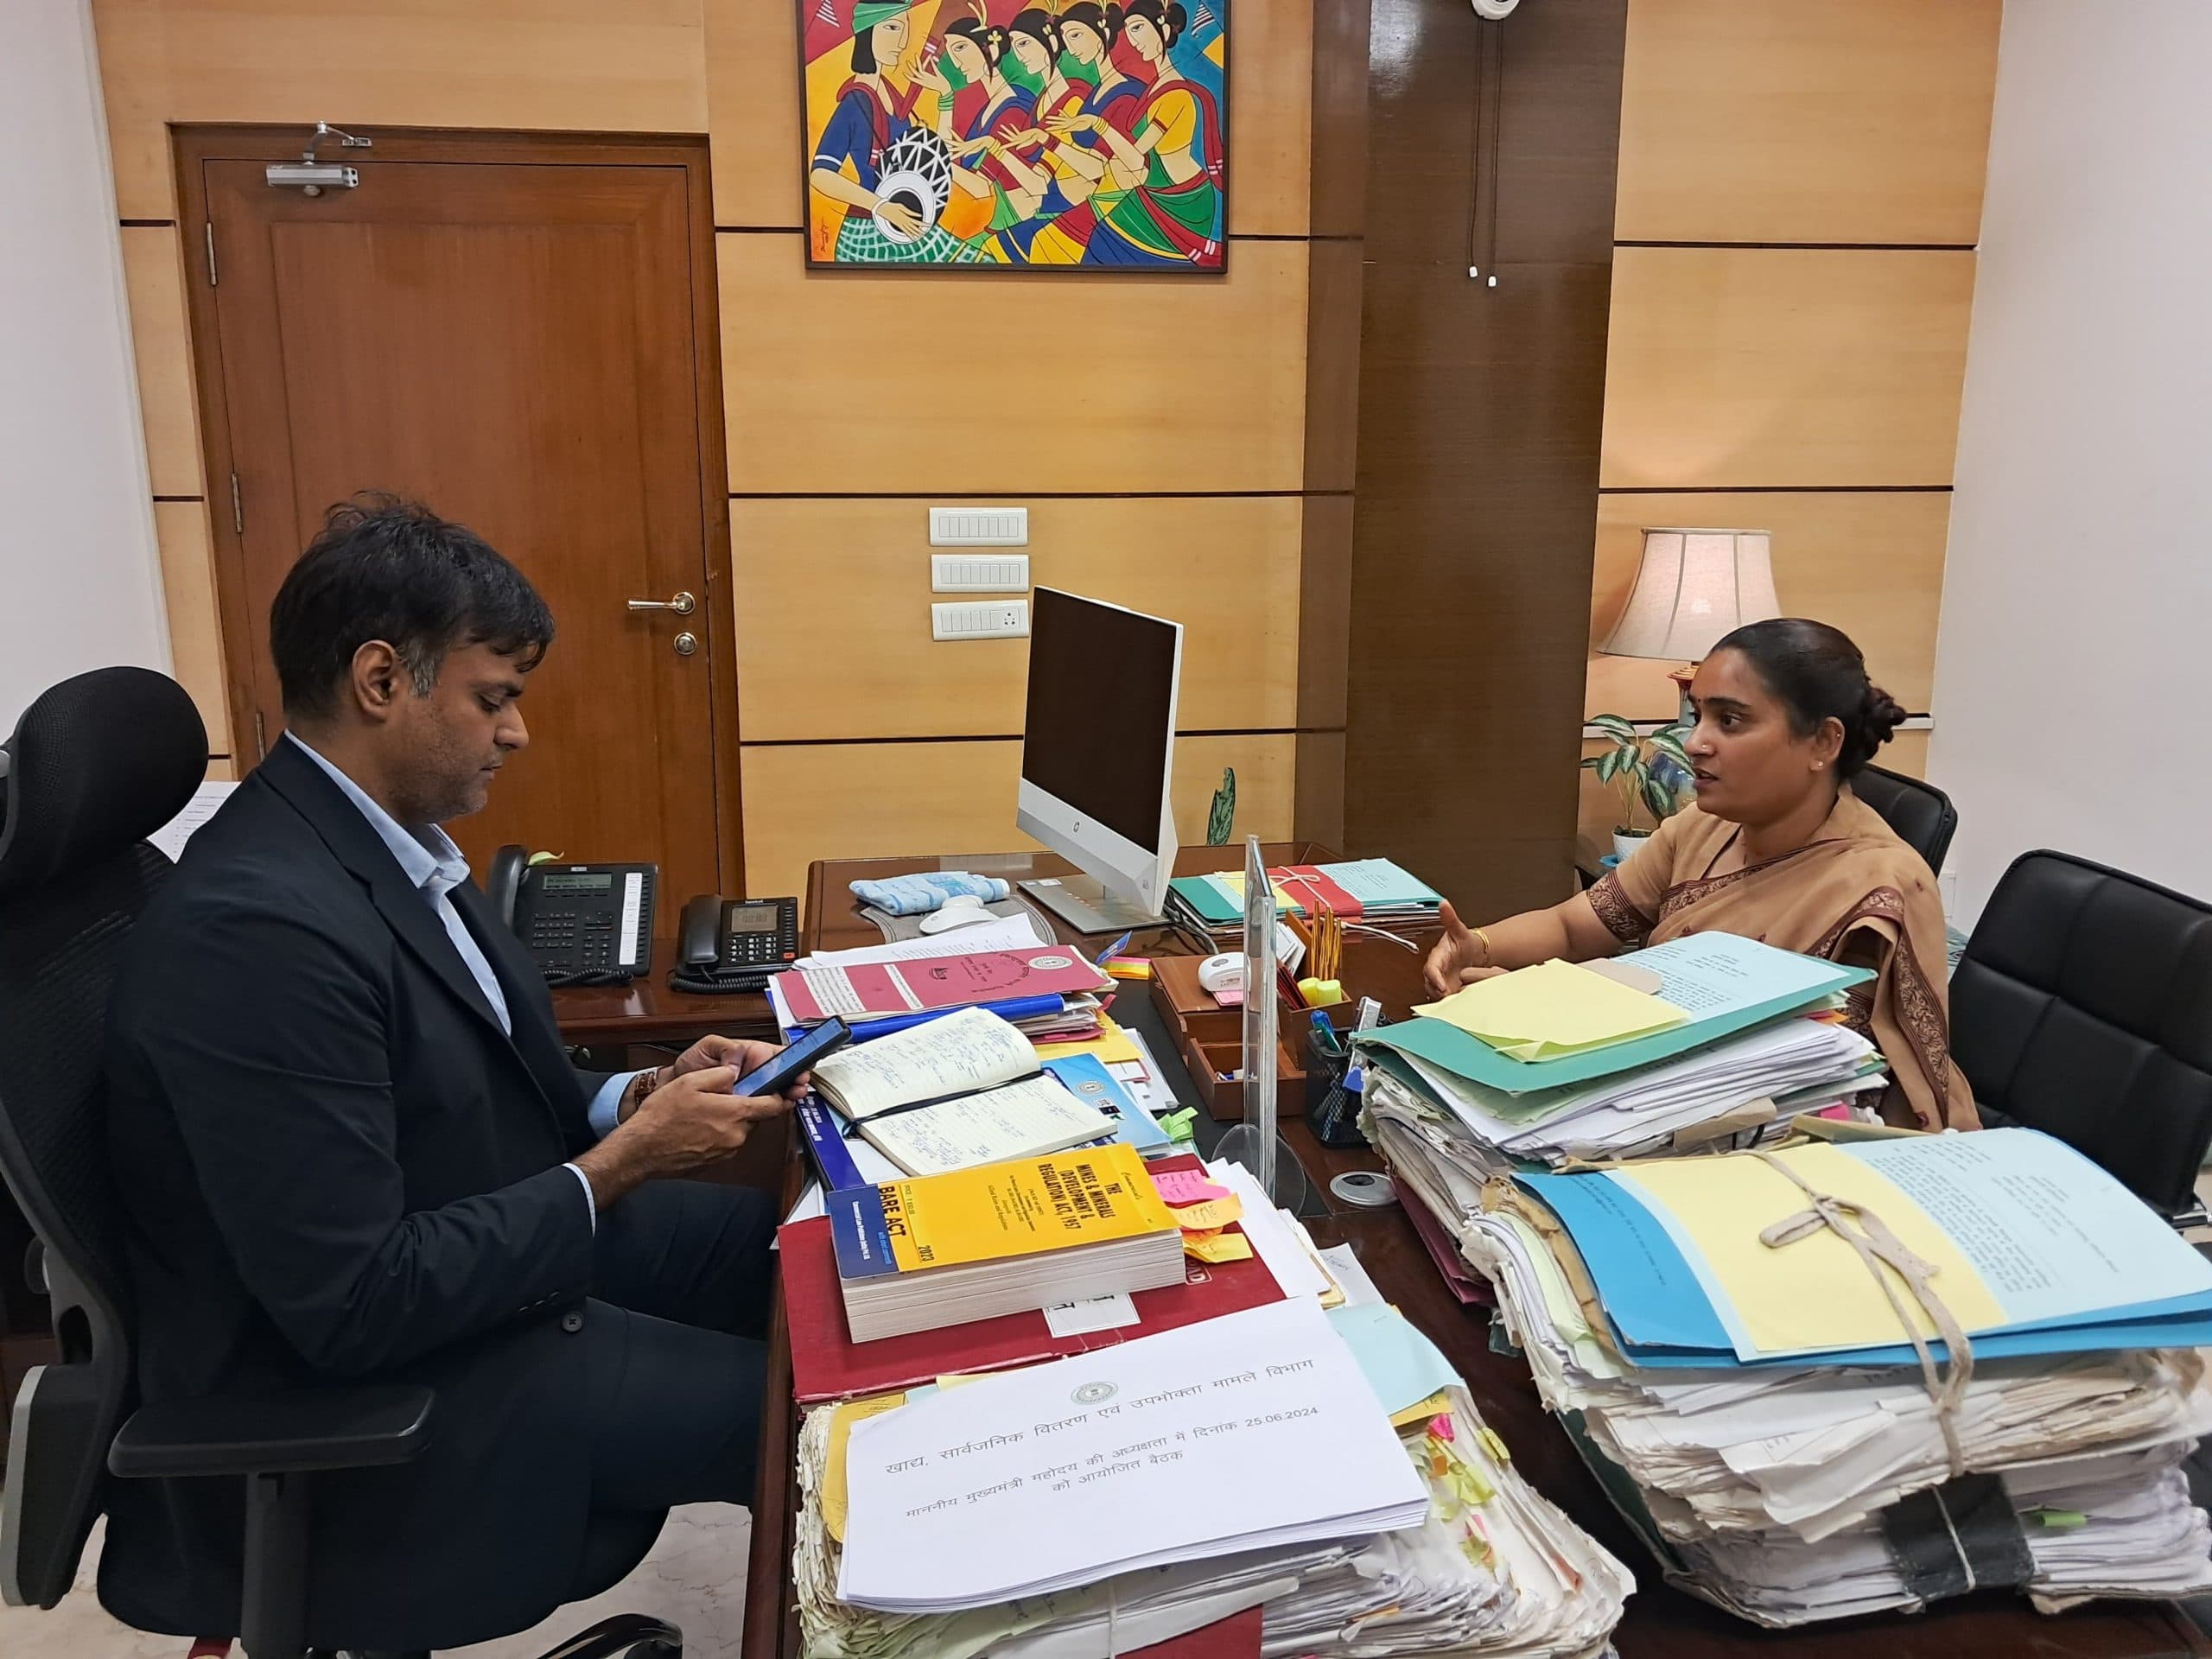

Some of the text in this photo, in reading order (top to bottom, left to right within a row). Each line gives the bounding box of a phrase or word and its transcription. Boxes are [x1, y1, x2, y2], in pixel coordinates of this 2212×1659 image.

[879, 1185, 906, 1236] BARE ACT
[1038, 1163, 1082, 1229] REGULATION) ACT, 1957
[1058, 1169, 1093, 1213] (DEVELOPMENT
[1076, 1163, 1097, 1183] MINES
[1089, 1191, 1116, 1218] MINERALS
[1104, 1183, 1122, 1195] THE
[918, 1245, 935, 1262] 2023
[938, 1432, 1024, 1459] सार्वजनिक
[1033, 1414, 1088, 1436] वितरण
[1096, 1402, 1122, 1418] एवं
[1128, 1384, 1203, 1408] उपभोक्ता
[1210, 1370, 1257, 1389] मामले
[1265, 1358, 1314, 1378] विभाग
[905, 1497, 958, 1516] माननीय
[965, 1477, 1023, 1503] मुख्यमंत्री
[1030, 1461, 1077, 1482] महोदय
[1084, 1452, 1103, 1466] की
[1111, 1436, 1168, 1459] अध्यक्षता
[1244, 1406, 1319, 1427] 25.06.2024
[1052, 1448, 1184, 1492] को आयोजित बैठक
